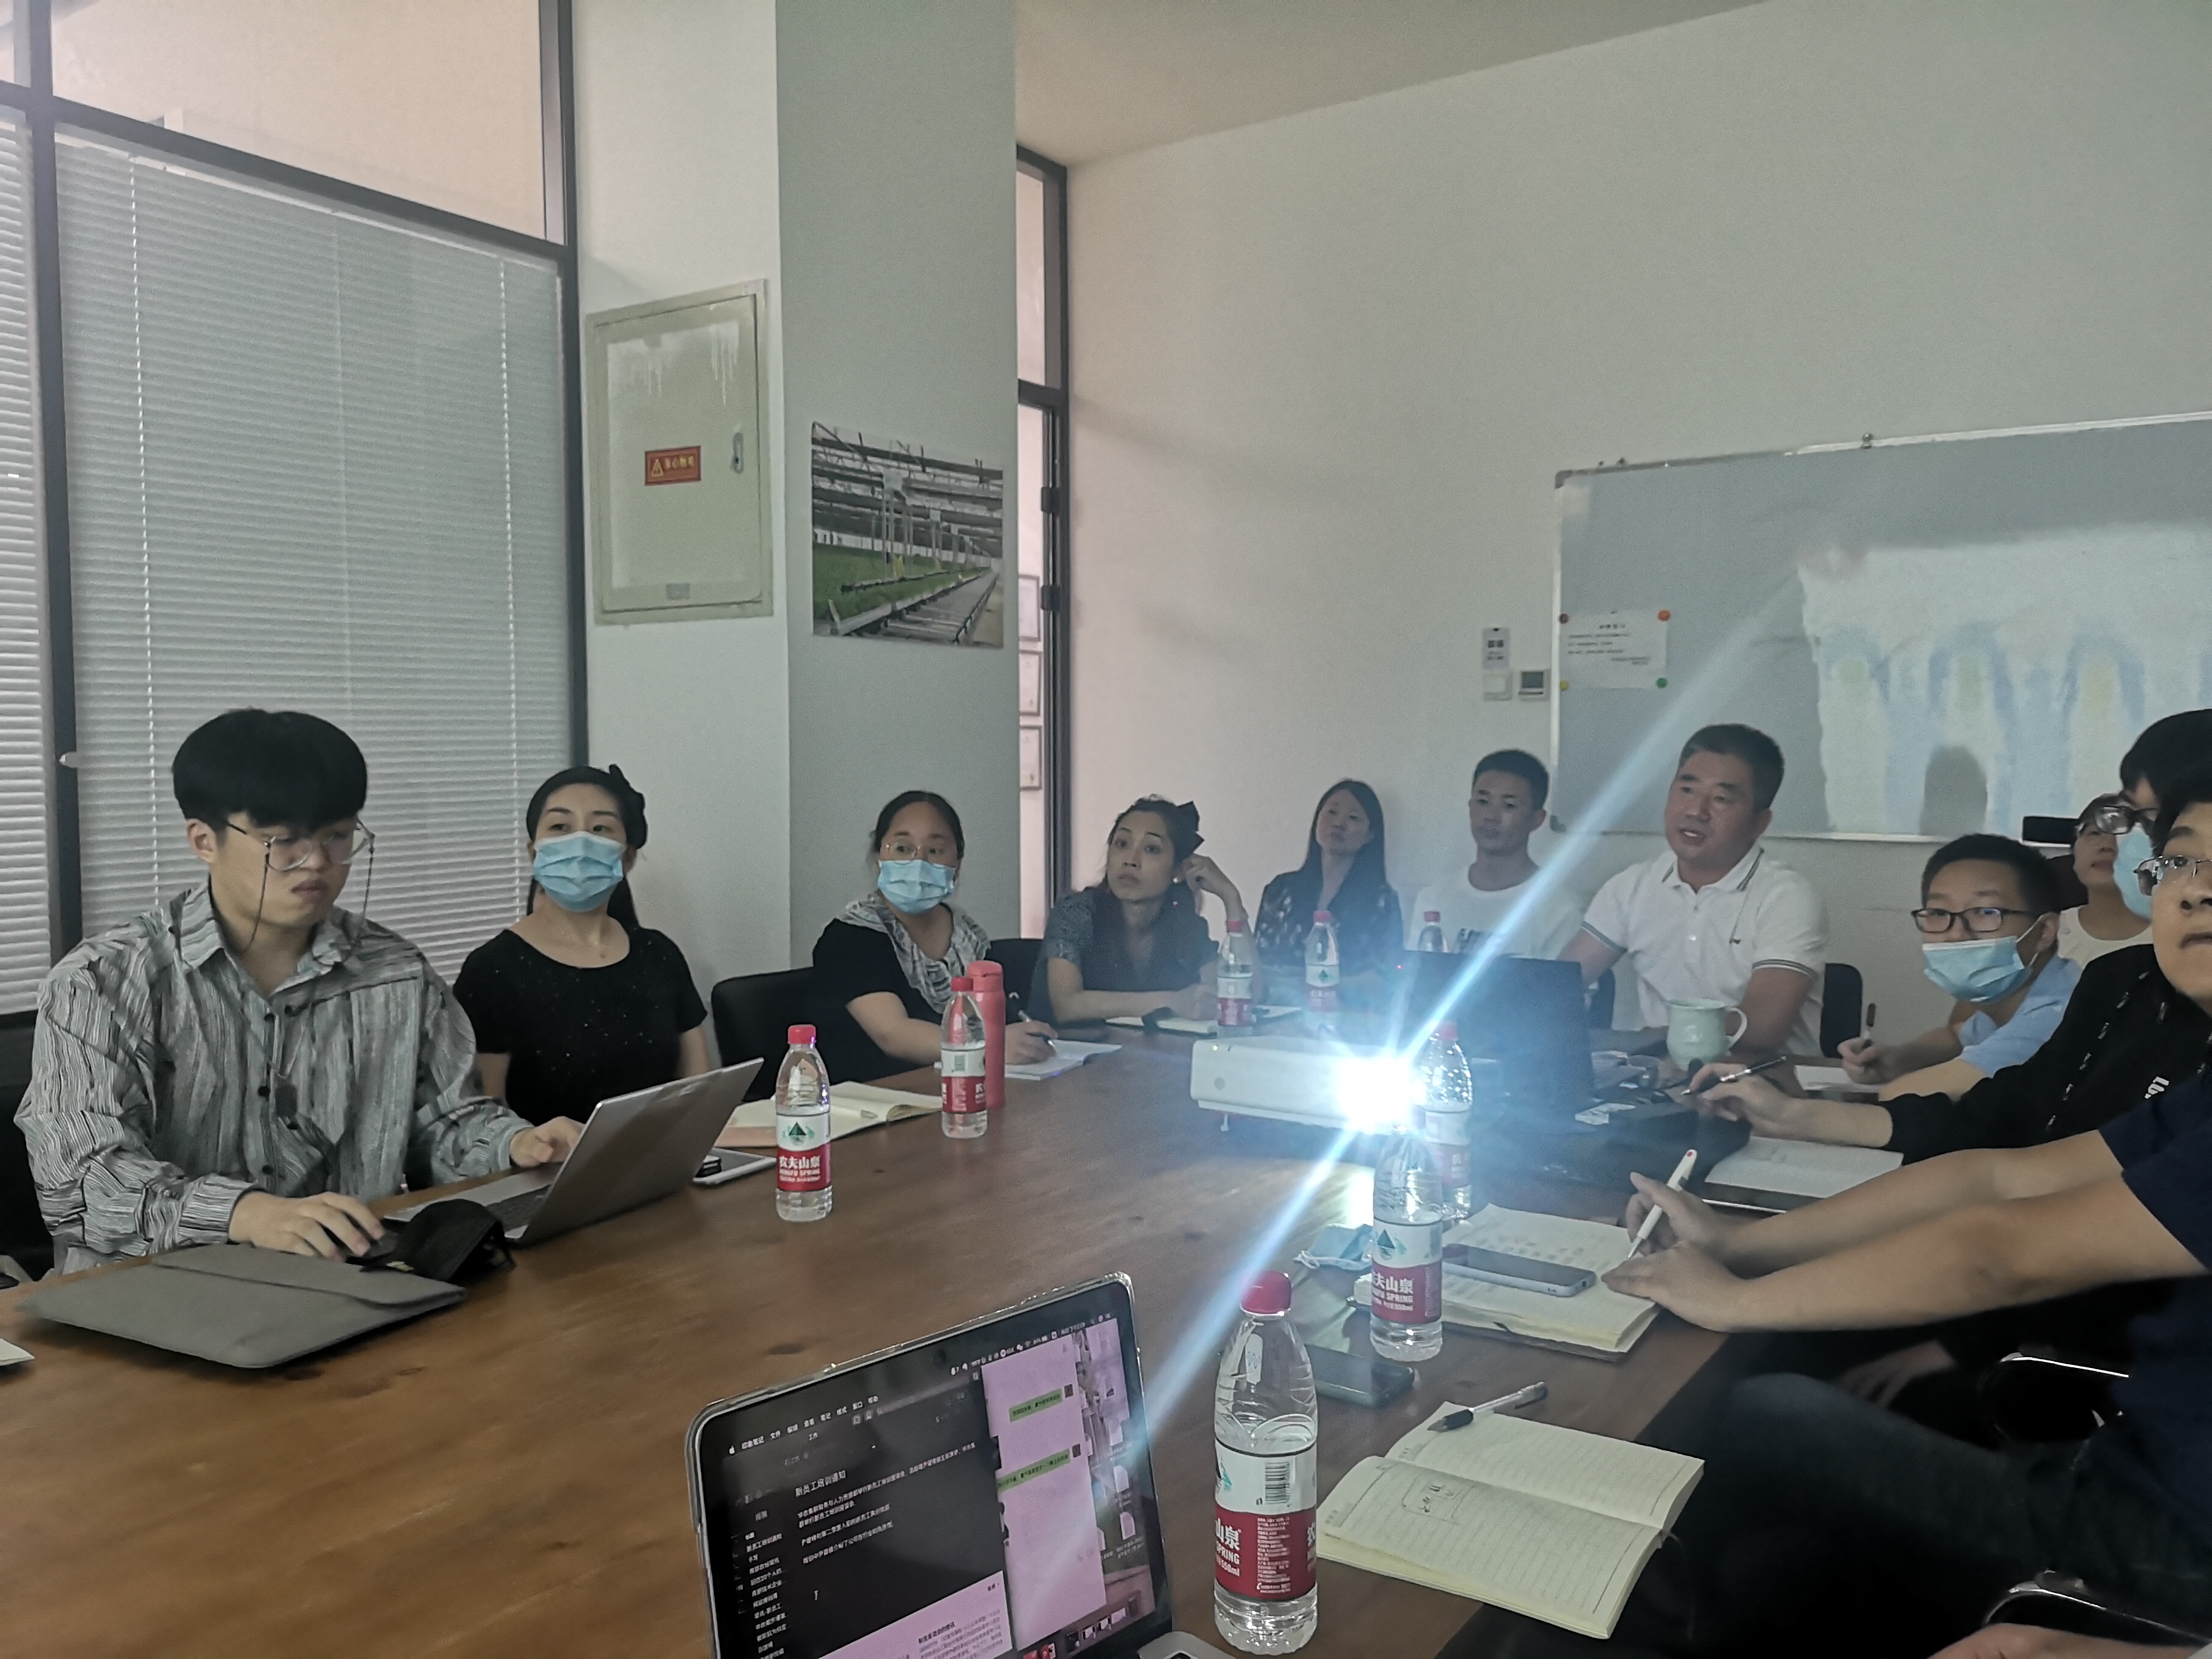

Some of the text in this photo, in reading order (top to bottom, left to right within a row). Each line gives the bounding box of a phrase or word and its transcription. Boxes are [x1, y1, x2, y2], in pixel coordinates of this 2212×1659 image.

[1372, 1271, 1413, 1294] 夫山泉
[796, 1470, 846, 1497] 新员工培训通知
